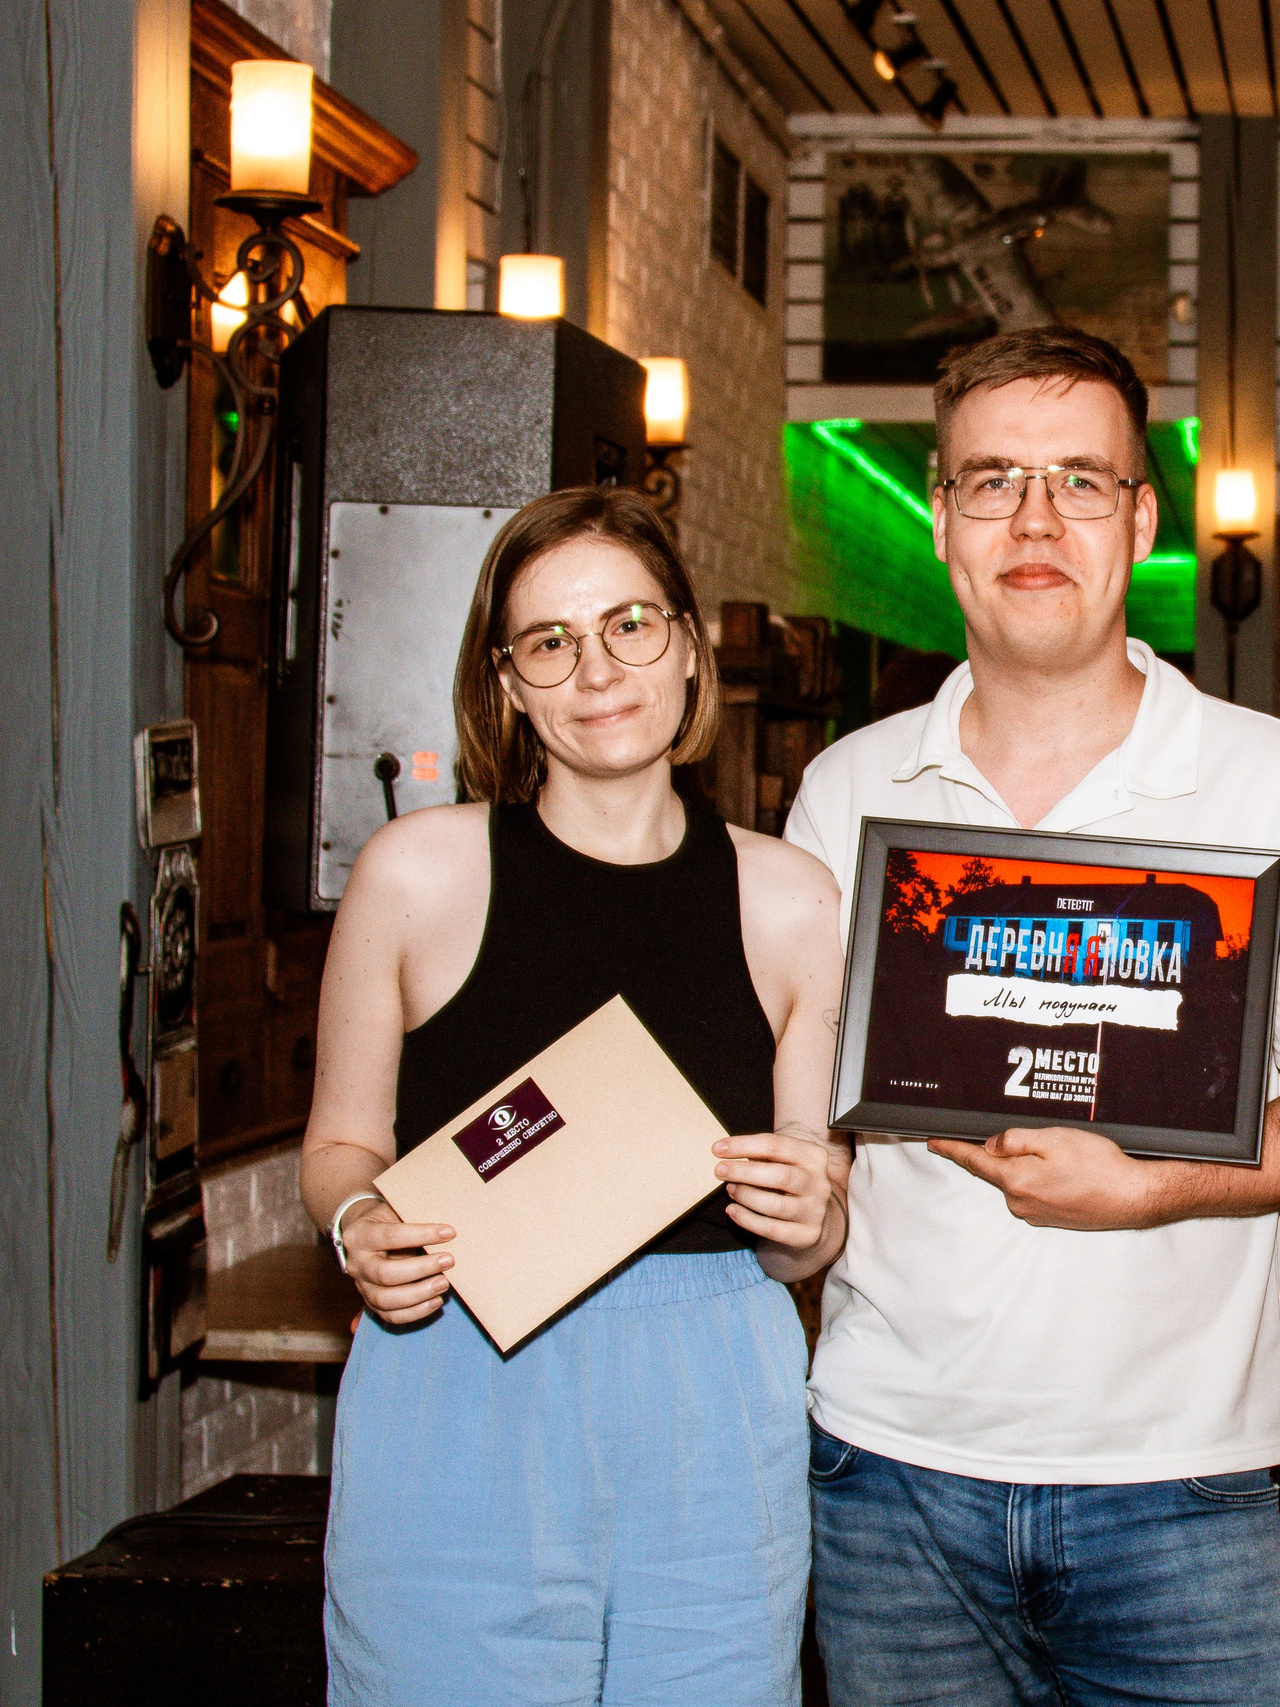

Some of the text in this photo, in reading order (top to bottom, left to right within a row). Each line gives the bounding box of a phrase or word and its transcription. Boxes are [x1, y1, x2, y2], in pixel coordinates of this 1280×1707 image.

[1056, 897, 1094, 911] DETECTIT
[964, 924, 1182, 983] ДЕРЕВНЯ ЯЛОВКА
[983, 987, 1026, 1009] Мы
[1004, 1046, 1099, 1098] 2 МЕСТО
[477, 1110, 558, 1173] СОВЕРШЕННО СЕКРЕТНО
[496, 1118, 530, 1146] 2 МЕСТО
